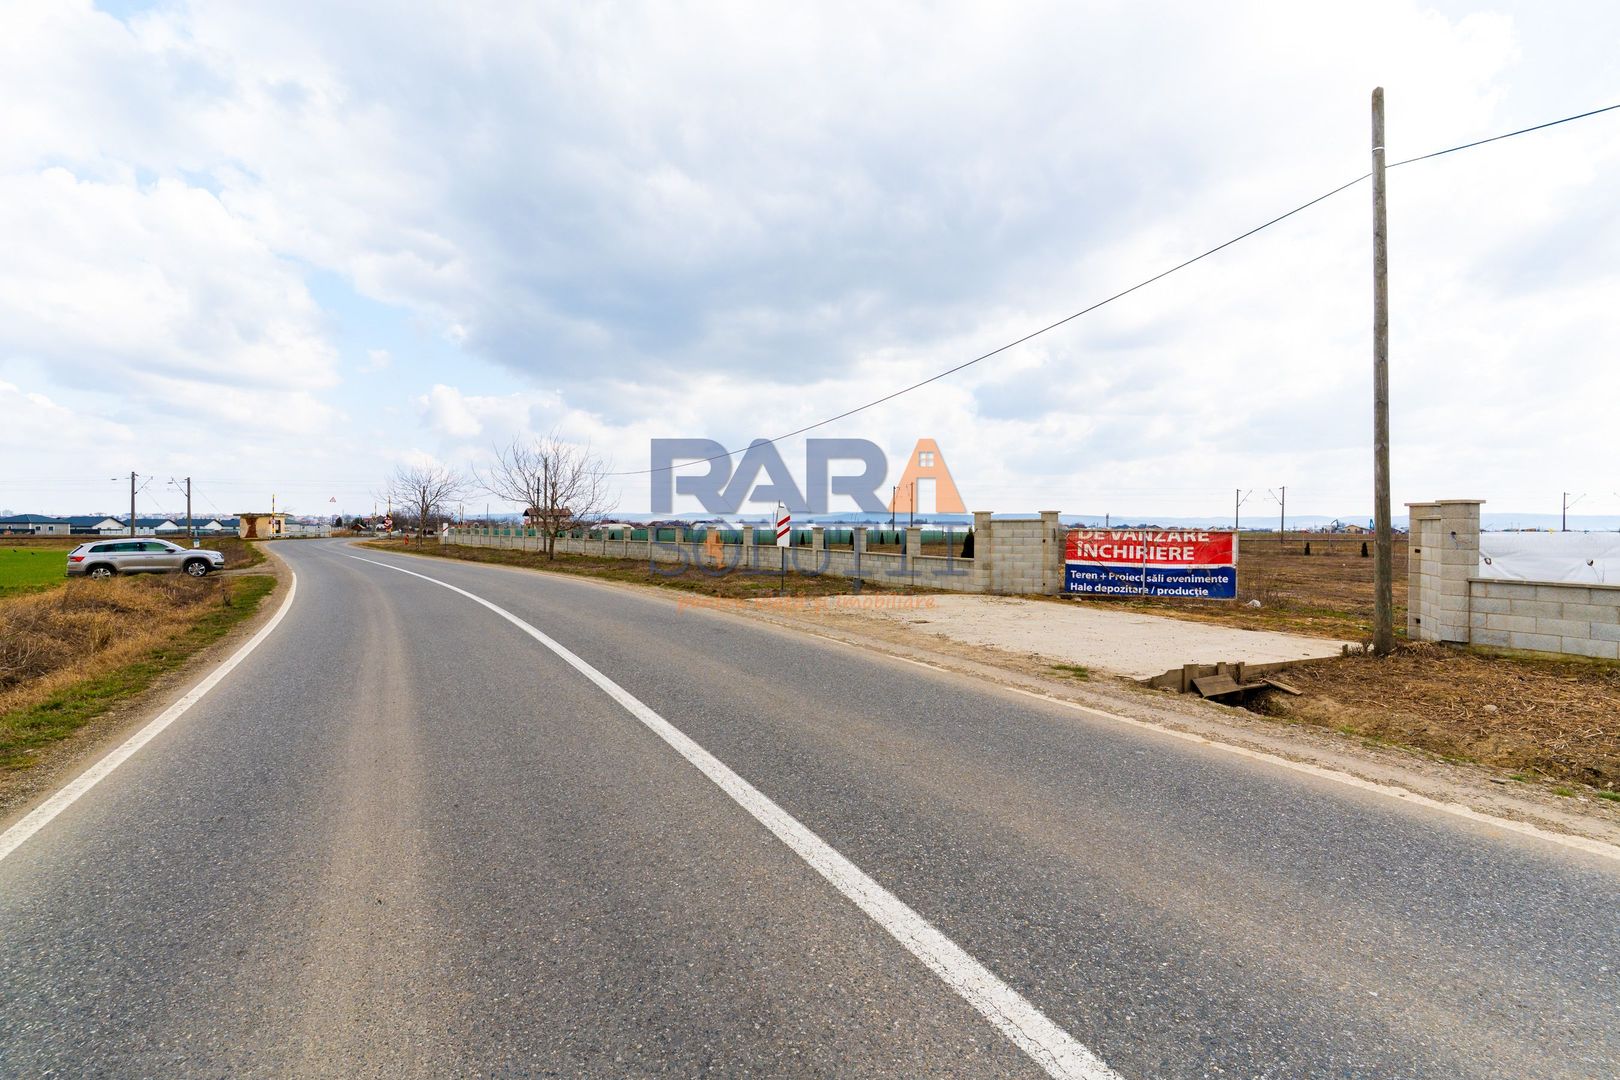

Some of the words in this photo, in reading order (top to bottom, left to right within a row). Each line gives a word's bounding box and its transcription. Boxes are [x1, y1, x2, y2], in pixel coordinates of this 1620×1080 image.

[1078, 531, 1105, 540] DE
[1070, 570, 1098, 580] Teren
[1108, 572, 1145, 582] Proiect
[1146, 574, 1164, 582] săli
[1166, 574, 1229, 583] evenimente
[1070, 582, 1093, 592] Hale
[1094, 583, 1149, 594] depozitare
